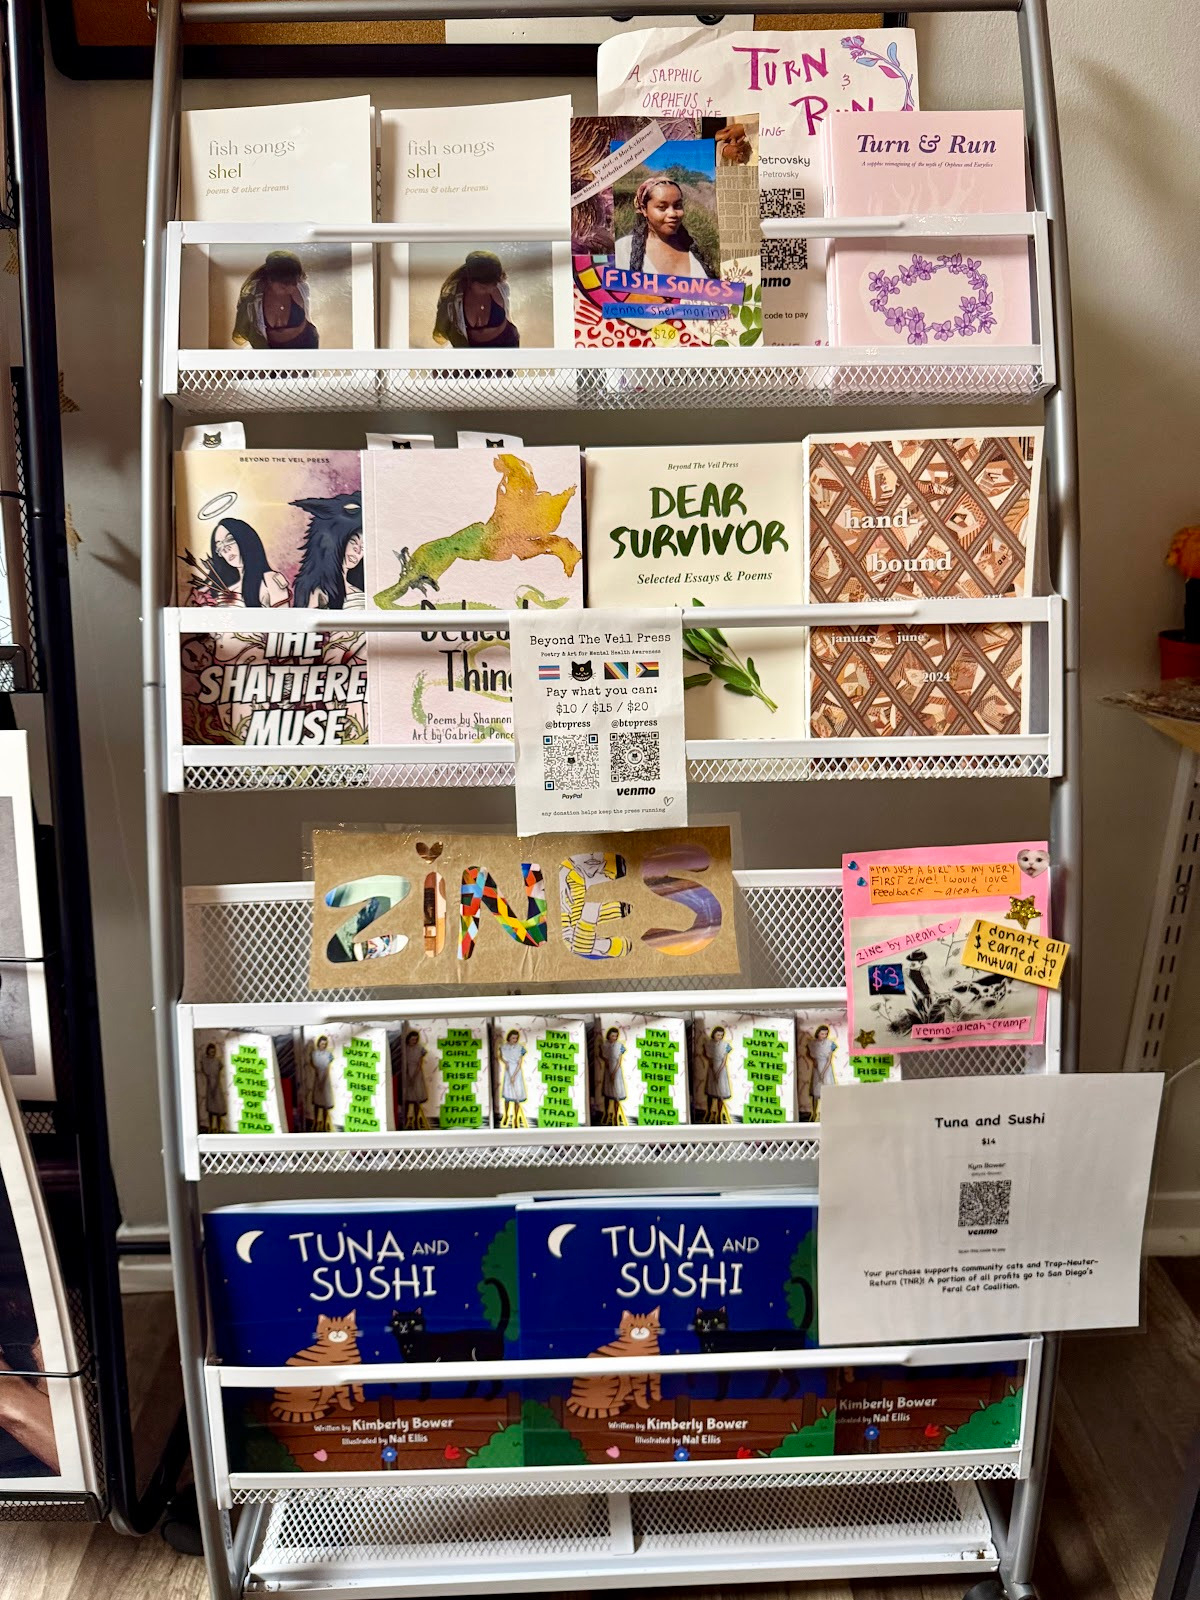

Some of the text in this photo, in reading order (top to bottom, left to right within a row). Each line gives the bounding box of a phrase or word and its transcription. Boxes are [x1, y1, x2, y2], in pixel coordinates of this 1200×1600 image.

[627, 64, 702, 83] A SAPPHIC
[732, 45, 829, 91] TURN
[642, 92, 699, 109] ORPHEUS
[209, 140, 295, 157] fish songs
[408, 140, 495, 157] fish songs
[857, 134, 997, 153] Turn & Run
[758, 155, 811, 167] Petrovsky
[208, 163, 242, 179] shel
[407, 163, 440, 179] shel
[206, 184, 289, 196] poems other dreams
[405, 184, 489, 195] poems other dreams
[605, 269, 734, 297] FISH SONGS
[604, 306, 645, 315] venmo
[794, 312, 809, 320] pay
[667, 462, 692, 471] Beyond
[707, 461, 720, 469] Veil
[721, 461, 739, 469] Press
[649, 482, 747, 519] DEAR
[609, 520, 789, 559] SURVIVOR
[870, 551, 953, 573] bound
[637, 570, 772, 585] Selected Essays & Poems
[265, 632, 324, 658] THE
[529, 633, 671, 648] Beyond The Veil Press
[830, 632, 925, 645] january june
[922, 671, 951, 683] 2024
[546, 686, 658, 699] Pay what you can:
[556, 700, 649, 716] $10 $15 $20
[245, 709, 347, 745] MUSE
[427, 712, 512, 727] Poems by Shannon
[545, 720, 591, 730] @btvpress
[611, 719, 658, 729] @btvpress
[412, 728, 486, 743] Art by Gabriela
[616, 787, 656, 796] venmo
[988, 864, 1015, 873] VERY
[871, 875, 903, 886] FIRST
[984, 875, 1008, 883] love
[887, 927, 936, 951] by Aleah
[989, 925, 1066, 956] donate all
[988, 939, 1056, 969] earned to
[977, 951, 1052, 982] mutual aid!
[872, 966, 899, 991] $3
[442, 1060, 451, 1068] &
[449, 1094, 473, 1102] THE
[934, 1112, 1046, 1128] Tuna and Sushi
[981, 1138, 996, 1146] $14
[288, 1228, 450, 1264] TUNA AND
[601, 1223, 760, 1260] TUNA AND
[885, 1268, 921, 1278] purchase
[924, 1266, 958, 1275] supports
[961, 1263, 1003, 1272] community
[1006, 1262, 1023, 1270] cats
[1044, 1259, 1099, 1269] Trap-Neuter-
[310, 1264, 437, 1301] SUSHI
[616, 1261, 743, 1299] SUSHI
[869, 1279, 897, 1287] Return
[937, 1275, 966, 1285] portion
[980, 1273, 991, 1281] all
[993, 1271, 1020, 1282] profits
[1065, 1267, 1093, 1277] Diego's
[942, 1285, 963, 1293] Feral
[983, 1282, 1020, 1291] Coalition.
[839, 1396, 938, 1412] Kimberly Bower
[314, 1417, 454, 1433] Written by Kimberly Bower
[608, 1417, 749, 1433] Written by Kimberly Bower
[862, 1416, 872, 1425] by
[872, 1413, 890, 1423] Nat
[891, 1413, 911, 1422] Ellis
[341, 1434, 428, 1446] Illustrated by Nat Ellis
[635, 1435, 721, 1445] Illustrated by Nat Ellis
